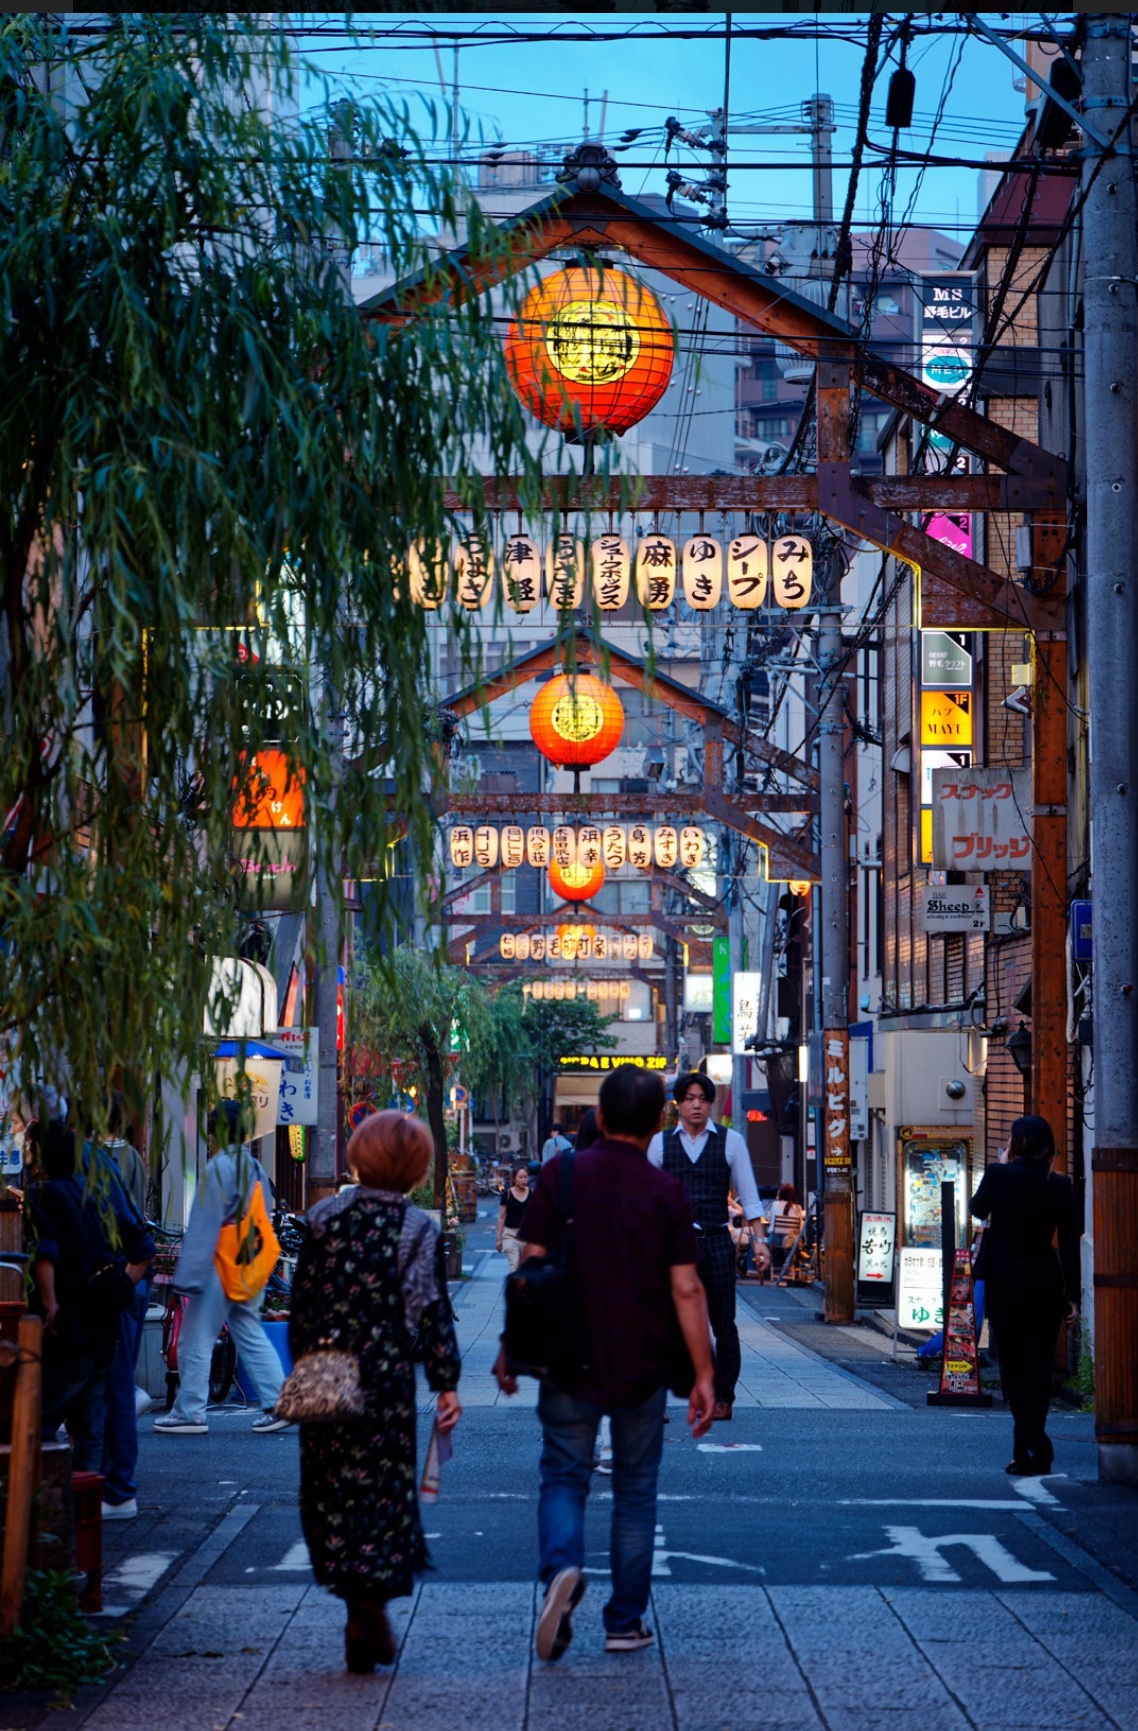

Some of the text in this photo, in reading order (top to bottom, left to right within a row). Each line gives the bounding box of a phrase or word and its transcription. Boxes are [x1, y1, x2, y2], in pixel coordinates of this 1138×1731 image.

[933, 288, 962, 301] MS
[924, 306, 971, 318] 野毛ビル
[957, 457, 966, 468] 2
[959, 517, 968, 529] 2
[506, 541, 536, 602] 津軽
[642, 541, 673, 603] 麻勇
[690, 540, 716, 602] ゆき
[732, 541, 764, 597] シープ
[776, 540, 810, 600] みち
[959, 634, 965, 646] 1
[955, 694, 968, 705] 1F
[927, 724, 965, 735] MAYU
[959, 755, 966, 766] 1
[941, 784, 1012, 800] スナック
[452, 829, 470, 863] 浜作
[582, 829, 599, 863] 浜幸
[607, 829, 623, 865] うたつ
[952, 832, 1031, 859] ブリッジ
[927, 900, 970, 914] Sheep
[973, 920, 986, 928] 2F
[827, 1039, 846, 1138] ミルビグ
